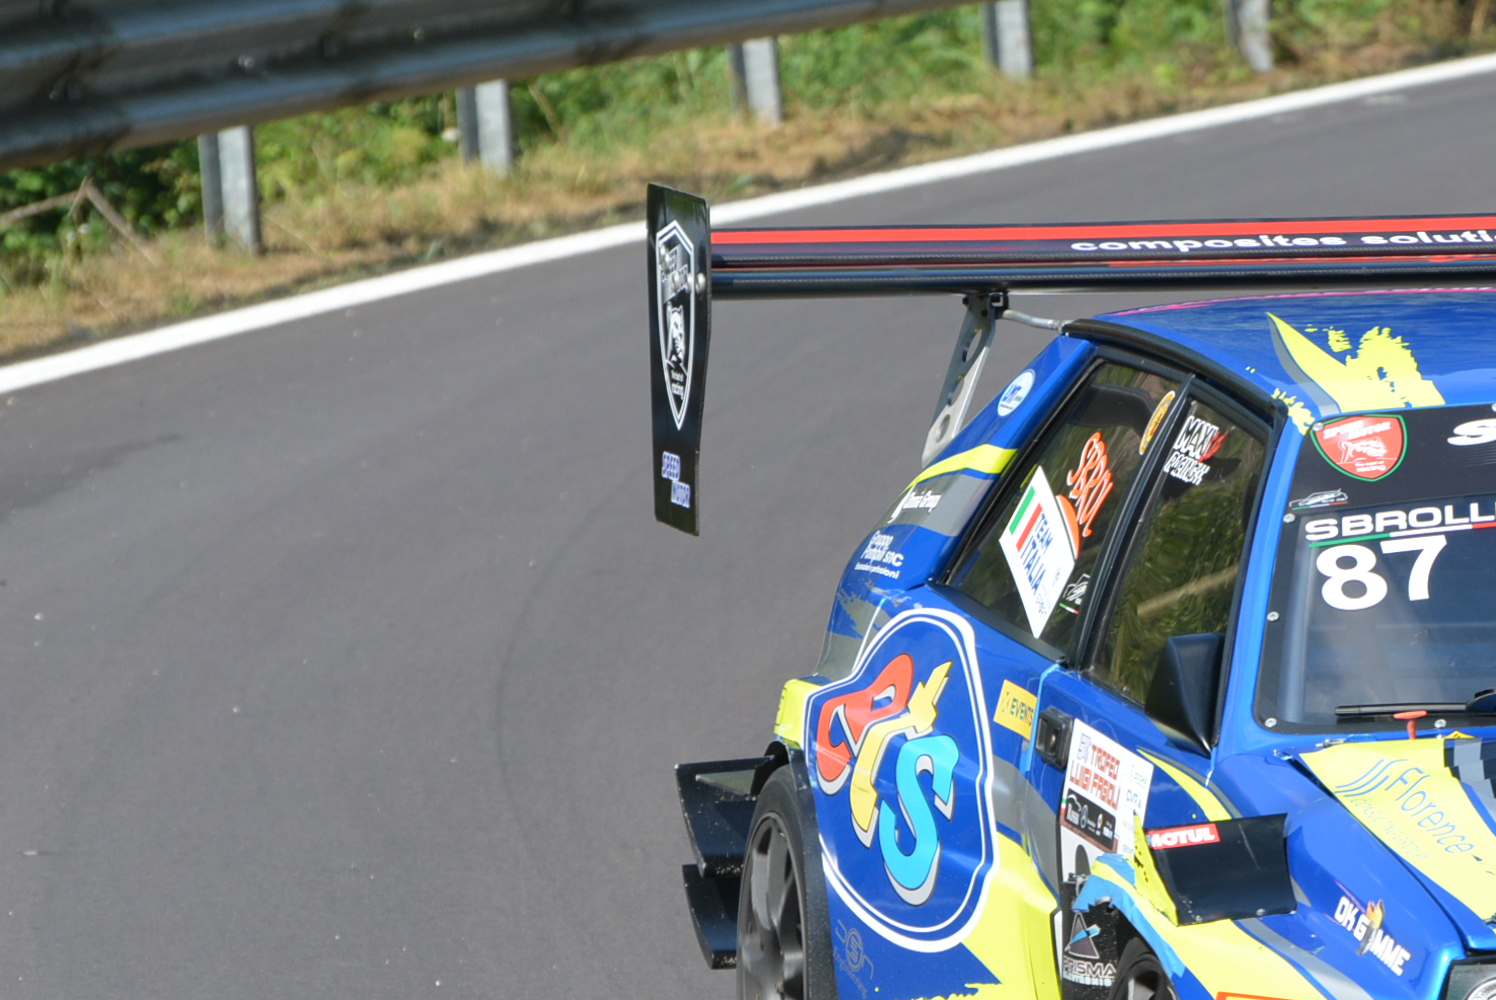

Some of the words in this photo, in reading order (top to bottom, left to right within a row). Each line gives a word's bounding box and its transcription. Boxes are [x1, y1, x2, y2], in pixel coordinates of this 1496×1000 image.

[1071, 234, 1347, 252] composites
[1323, 420, 1364, 439] SPEED
[1347, 421, 1391, 440] MOTOR
[1035, 512, 1053, 555] TEAM
[1020, 535, 1046, 596] ITALIA
[1316, 535, 1447, 610] 87
[1091, 744, 1121, 781] TROFEO
[1384, 767, 1475, 854] Florence
[1146, 826, 1215, 848] MOTUL
[1334, 895, 1359, 932] OK
[1063, 955, 1117, 979] PRISMA
